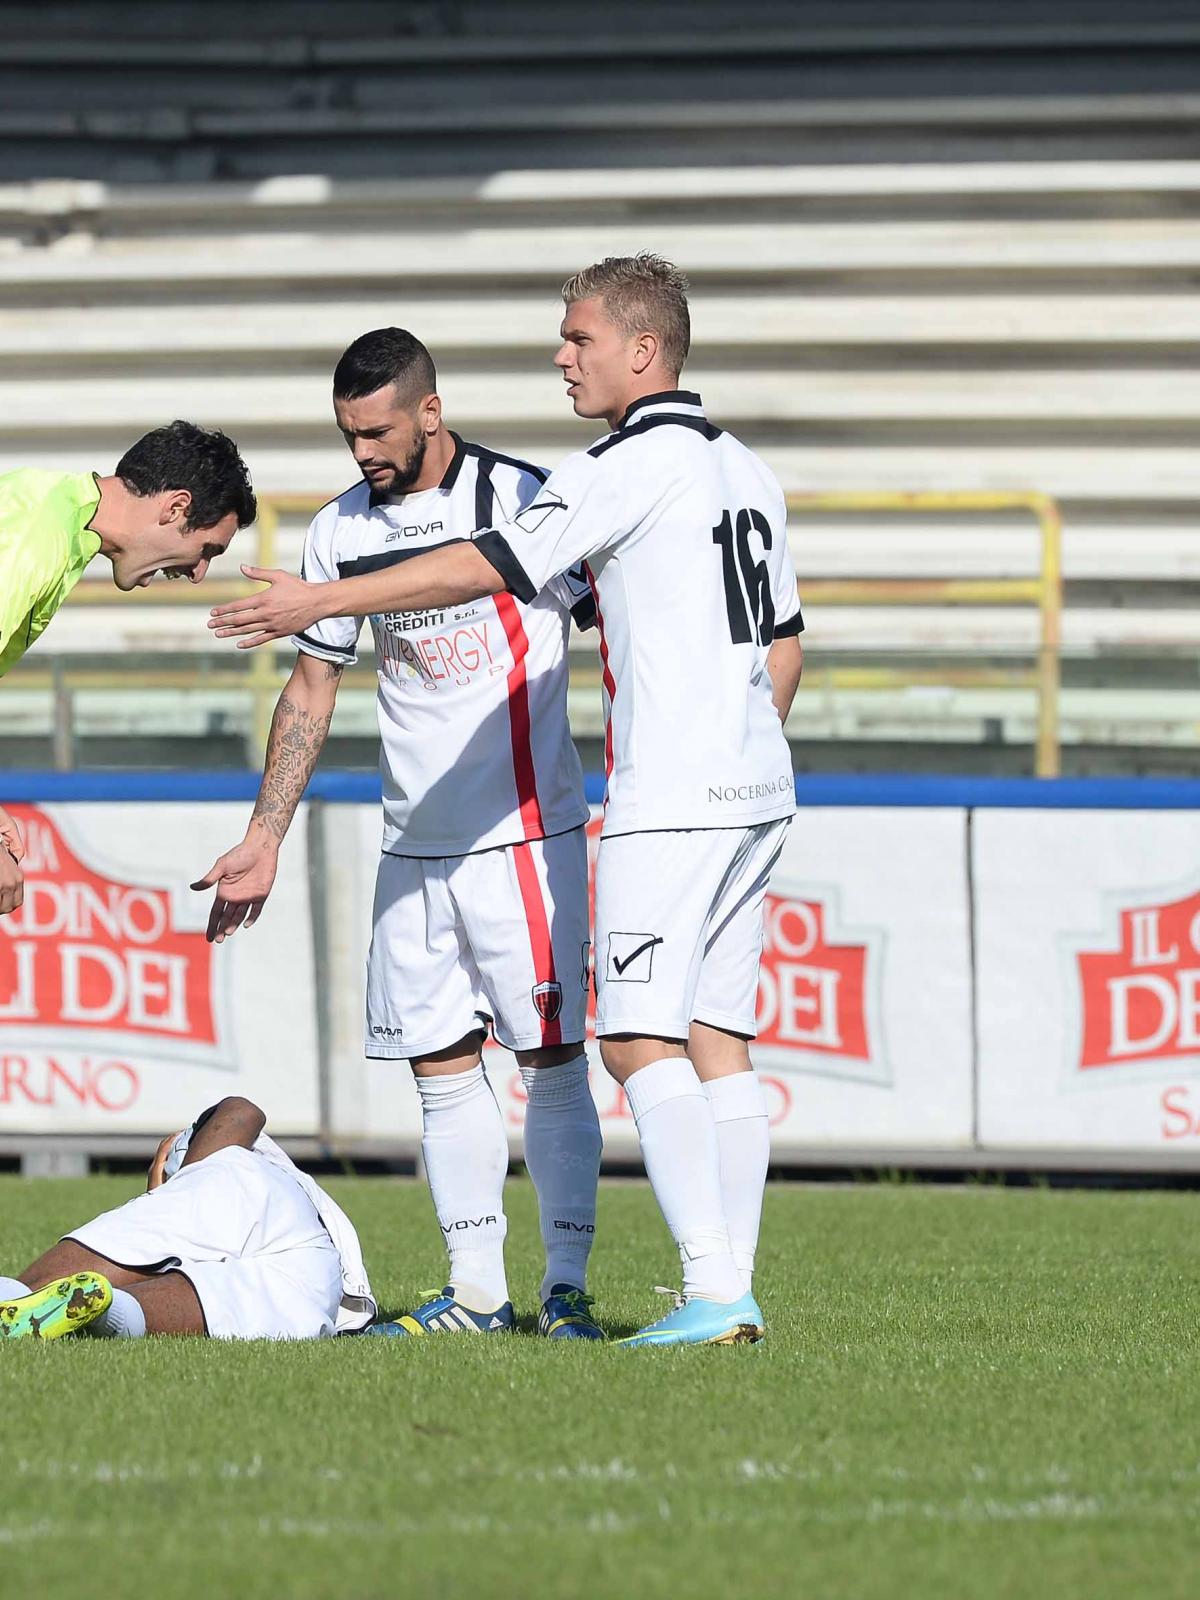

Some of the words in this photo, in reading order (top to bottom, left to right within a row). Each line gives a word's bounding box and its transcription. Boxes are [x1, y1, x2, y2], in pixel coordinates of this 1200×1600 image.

[385, 521, 443, 542] GIVOVA
[712, 508, 775, 647] 16
[385, 612, 444, 633] CREDITI
[454, 608, 479, 621] s.r.l.
[708, 782, 777, 802] NOCERINA
[1130, 910, 1179, 967] IL
[59, 943, 191, 1031] DEI
[441, 1215, 496, 1233] VOVA
[554, 1220, 595, 1233] GIVO
